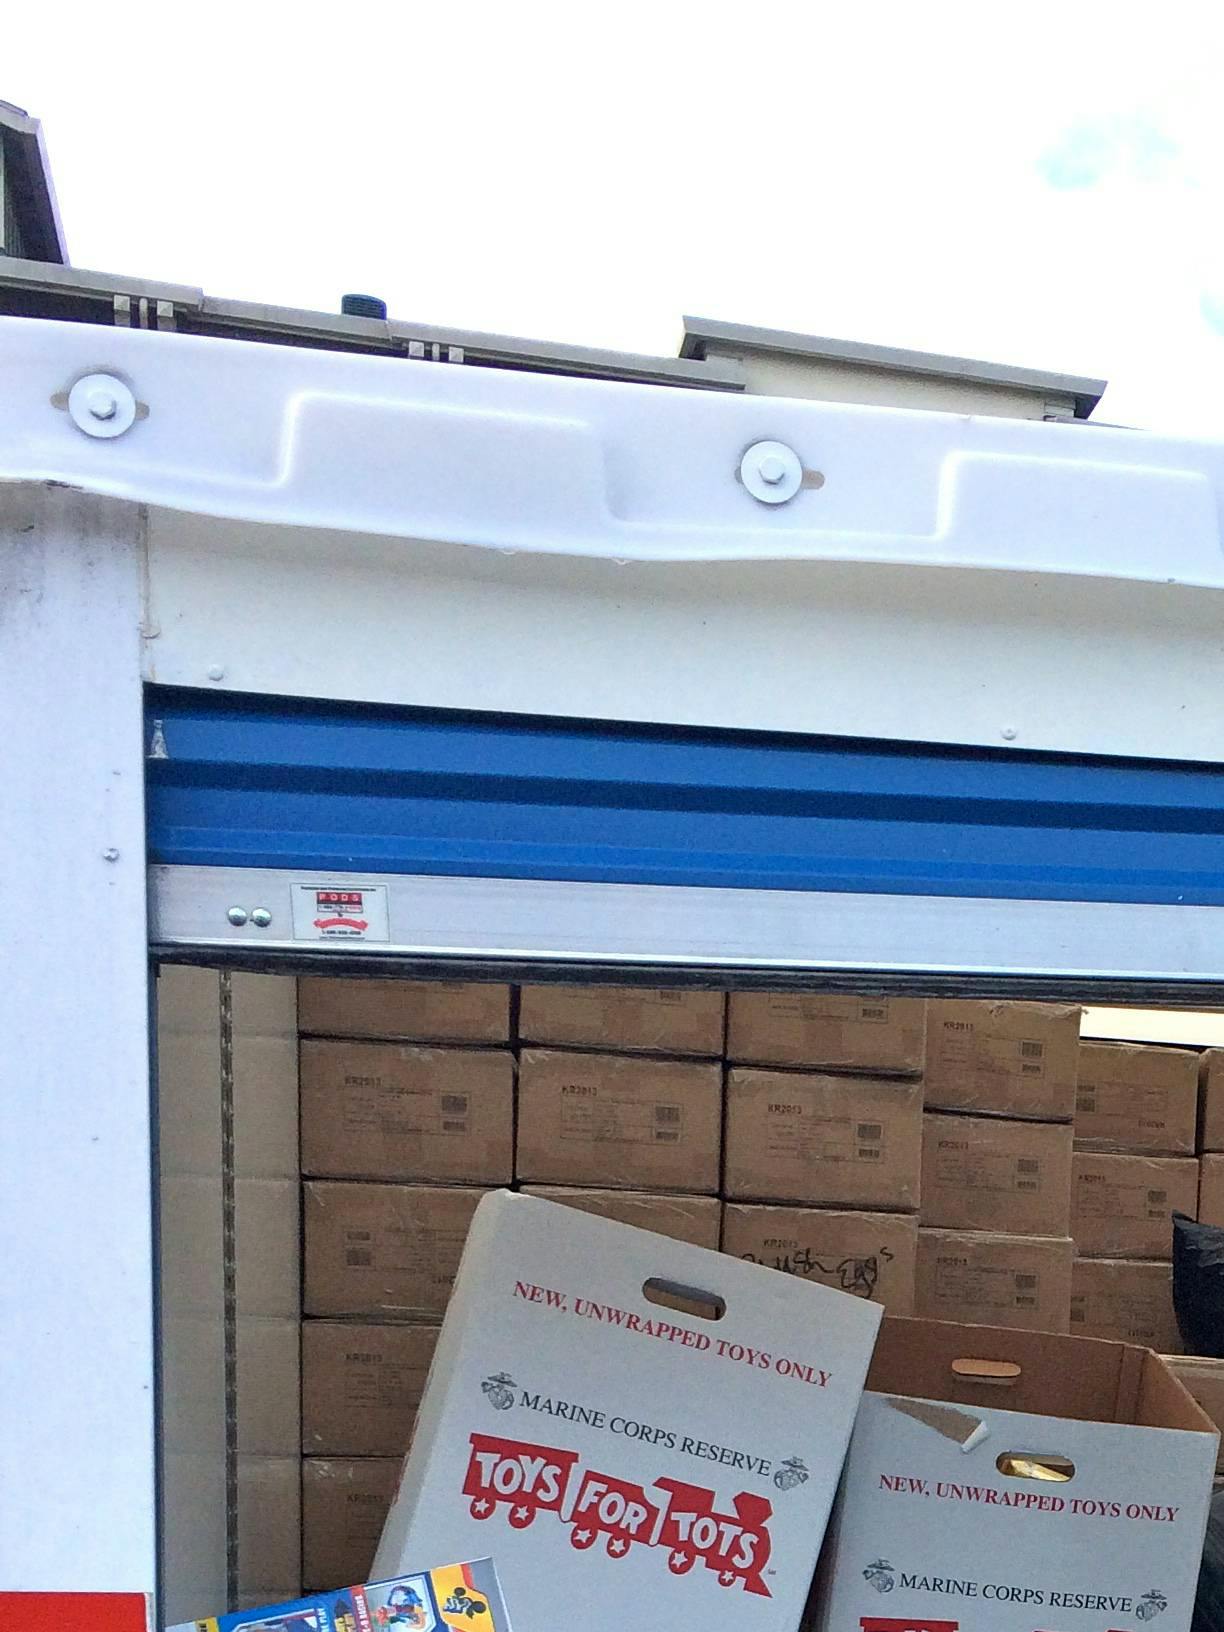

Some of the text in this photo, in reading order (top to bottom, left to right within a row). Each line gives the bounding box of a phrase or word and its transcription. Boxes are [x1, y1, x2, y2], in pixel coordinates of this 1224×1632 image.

[513, 1280, 833, 1388] NEW, UNWRAPPED TOYS ONLY
[519, 1391, 772, 1477] MARINE CORPS RESERVE
[475, 1451, 759, 1570] TOYS FOR TOTS
[879, 1474, 1180, 1522] NEW, UNWRAPPED TOYS ONLY
[899, 1573, 1133, 1613] MARINE CORPS RESERVE
